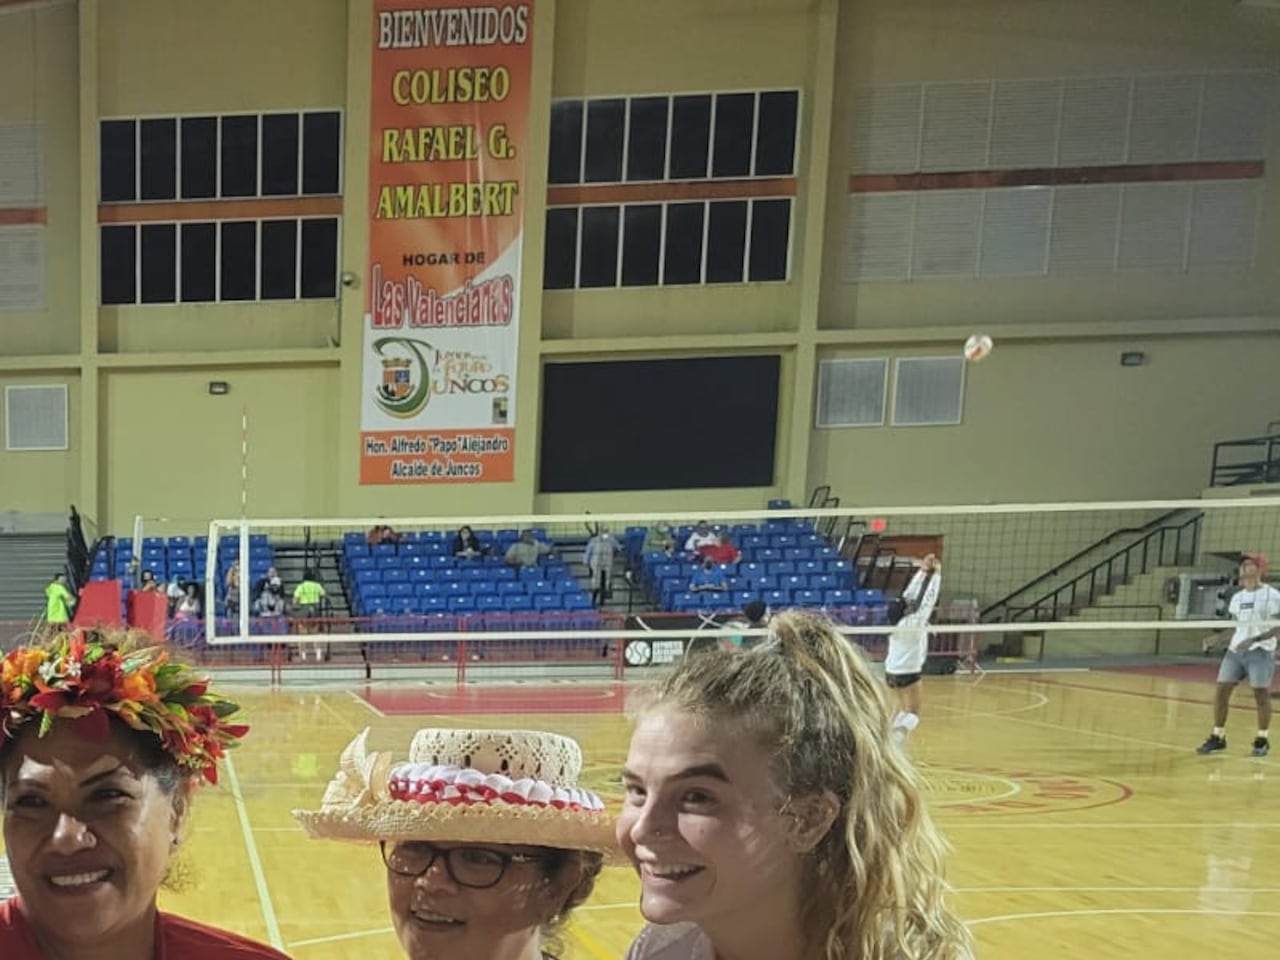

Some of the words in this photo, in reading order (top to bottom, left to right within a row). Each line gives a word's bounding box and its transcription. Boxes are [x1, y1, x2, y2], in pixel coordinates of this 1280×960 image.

[378, 5, 528, 49] BIENVENIDOS
[392, 66, 510, 105] COLISEO
[382, 126, 478, 163] RAFAEL
[488, 124, 515, 159] G.
[376, 180, 518, 220] AMALBERT
[402, 252, 460, 267] HOGAR
[463, 251, 485, 265] DE
[371, 264, 405, 329] Las
[366, 437, 388, 454] Hon.
[391, 436, 426, 453] Alfredo
[461, 434, 508, 455] Alejandro
[391, 461, 430, 477] Alcalde
[430, 462, 443, 476] de
[445, 461, 481, 477] Juncos
